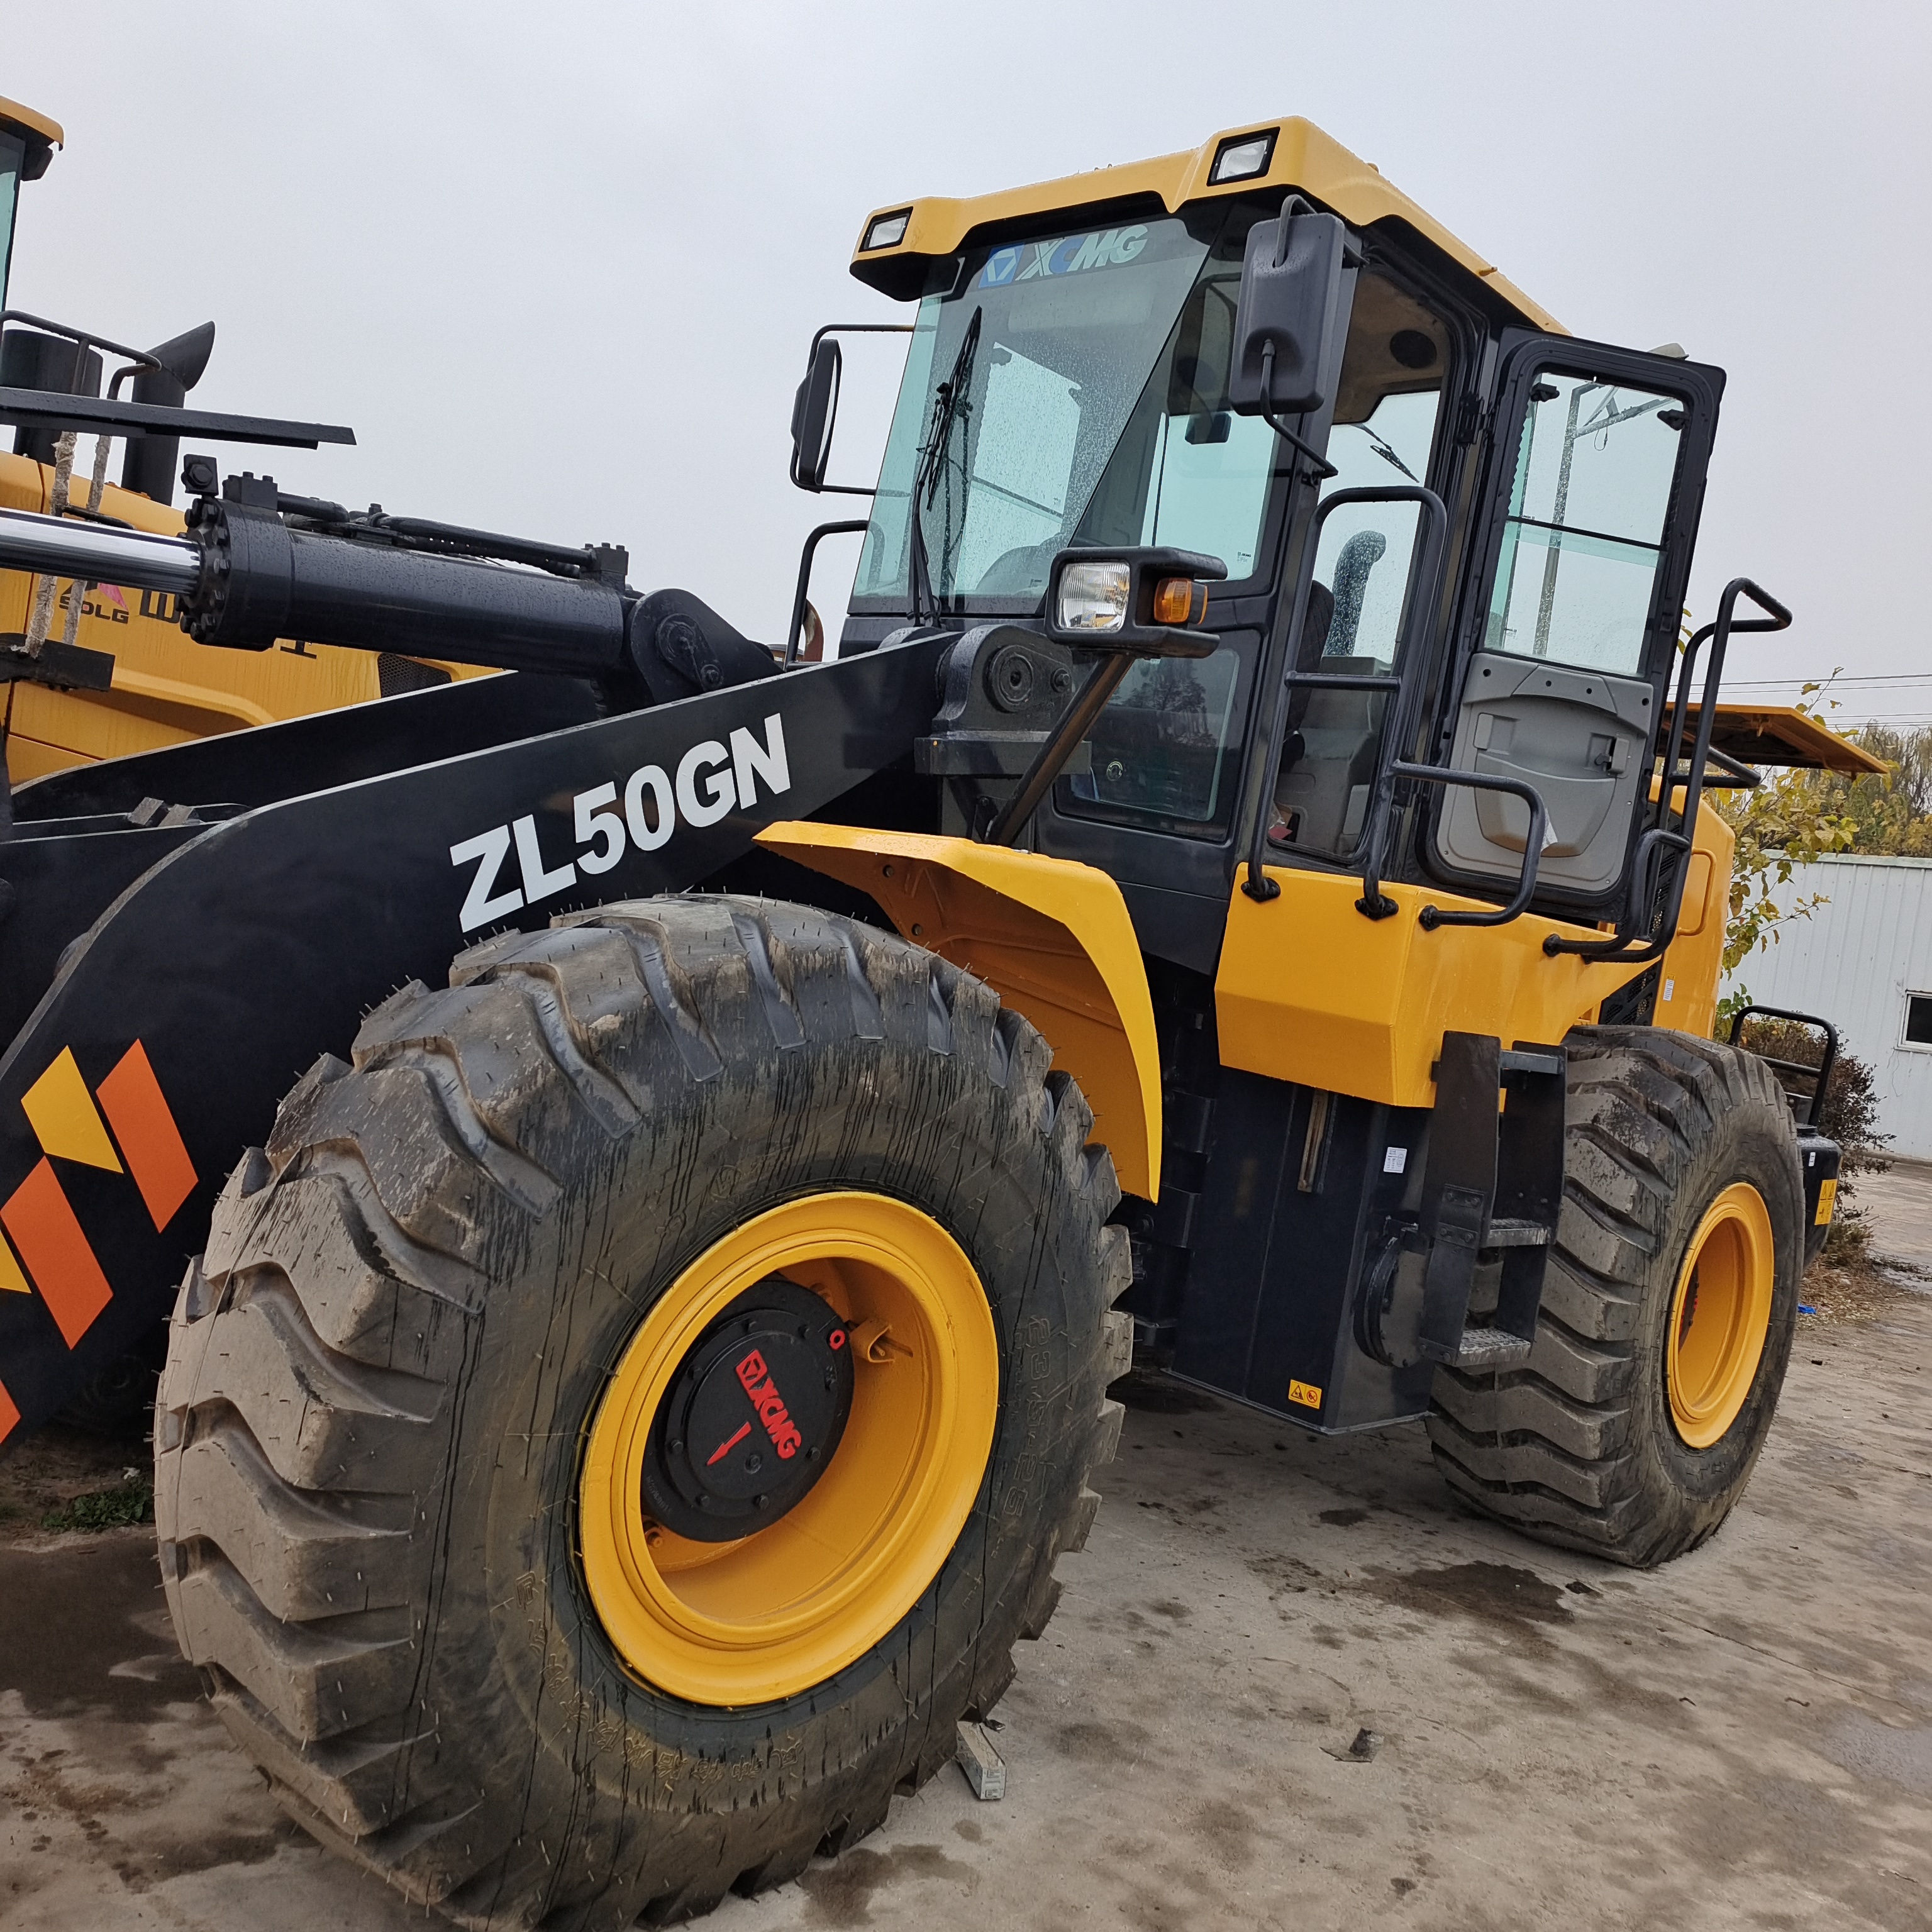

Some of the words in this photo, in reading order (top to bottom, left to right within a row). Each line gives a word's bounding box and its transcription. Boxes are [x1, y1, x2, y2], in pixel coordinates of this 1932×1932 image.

[1015, 225, 1148, 281] XCMG
[450, 713, 791, 933] ZL50GN
[749, 1376, 801, 1459] XCMG
